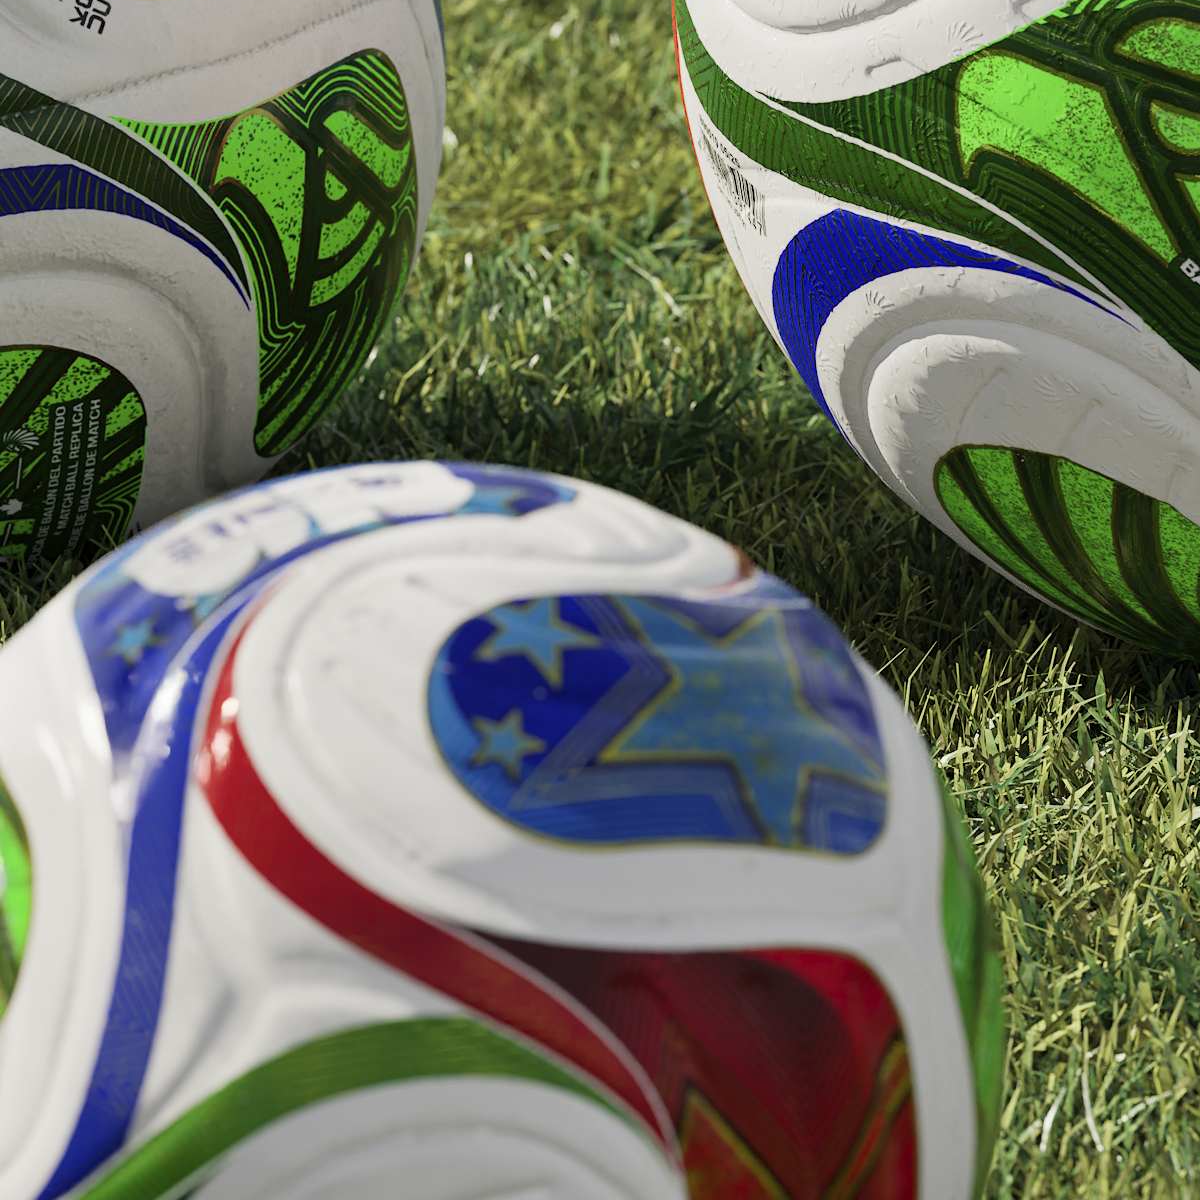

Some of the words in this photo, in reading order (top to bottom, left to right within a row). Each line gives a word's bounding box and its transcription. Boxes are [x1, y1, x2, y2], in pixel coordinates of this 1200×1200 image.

[69, 7, 106, 35] UK
[51, 405, 67, 464] PARTIDO
[68, 402, 84, 459] REPLICA
[87, 399, 101, 449] MATCH
[48, 464, 61, 487] DEL
[65, 461, 79, 491] BALL
[85, 449, 97, 467] DE
[78, 468, 95, 512] BALLON
[58, 492, 75, 530] MATCH
